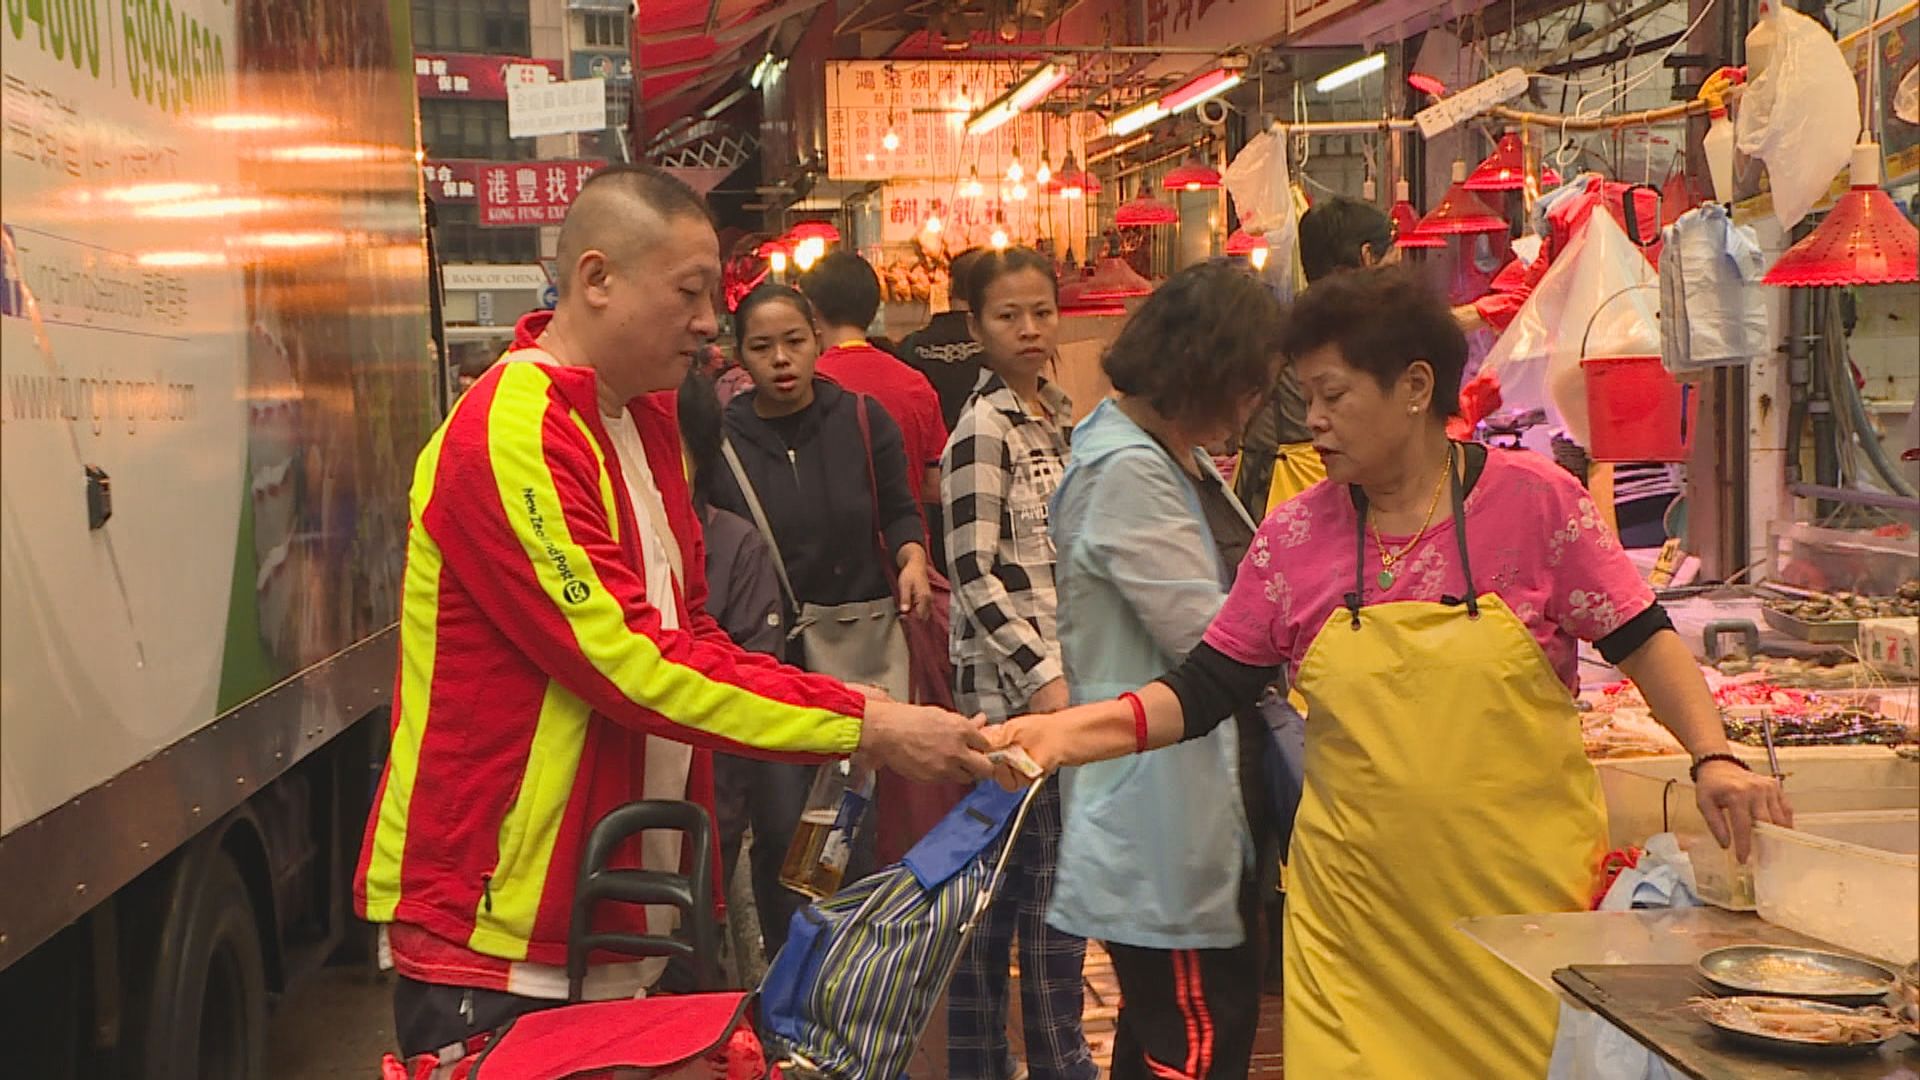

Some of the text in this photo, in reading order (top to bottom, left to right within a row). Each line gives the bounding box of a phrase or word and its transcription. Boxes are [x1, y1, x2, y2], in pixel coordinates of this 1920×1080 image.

[452, 274, 541, 283] BANK OF CHINA
[522, 488, 537, 515] New
[551, 554, 575, 581] Post
